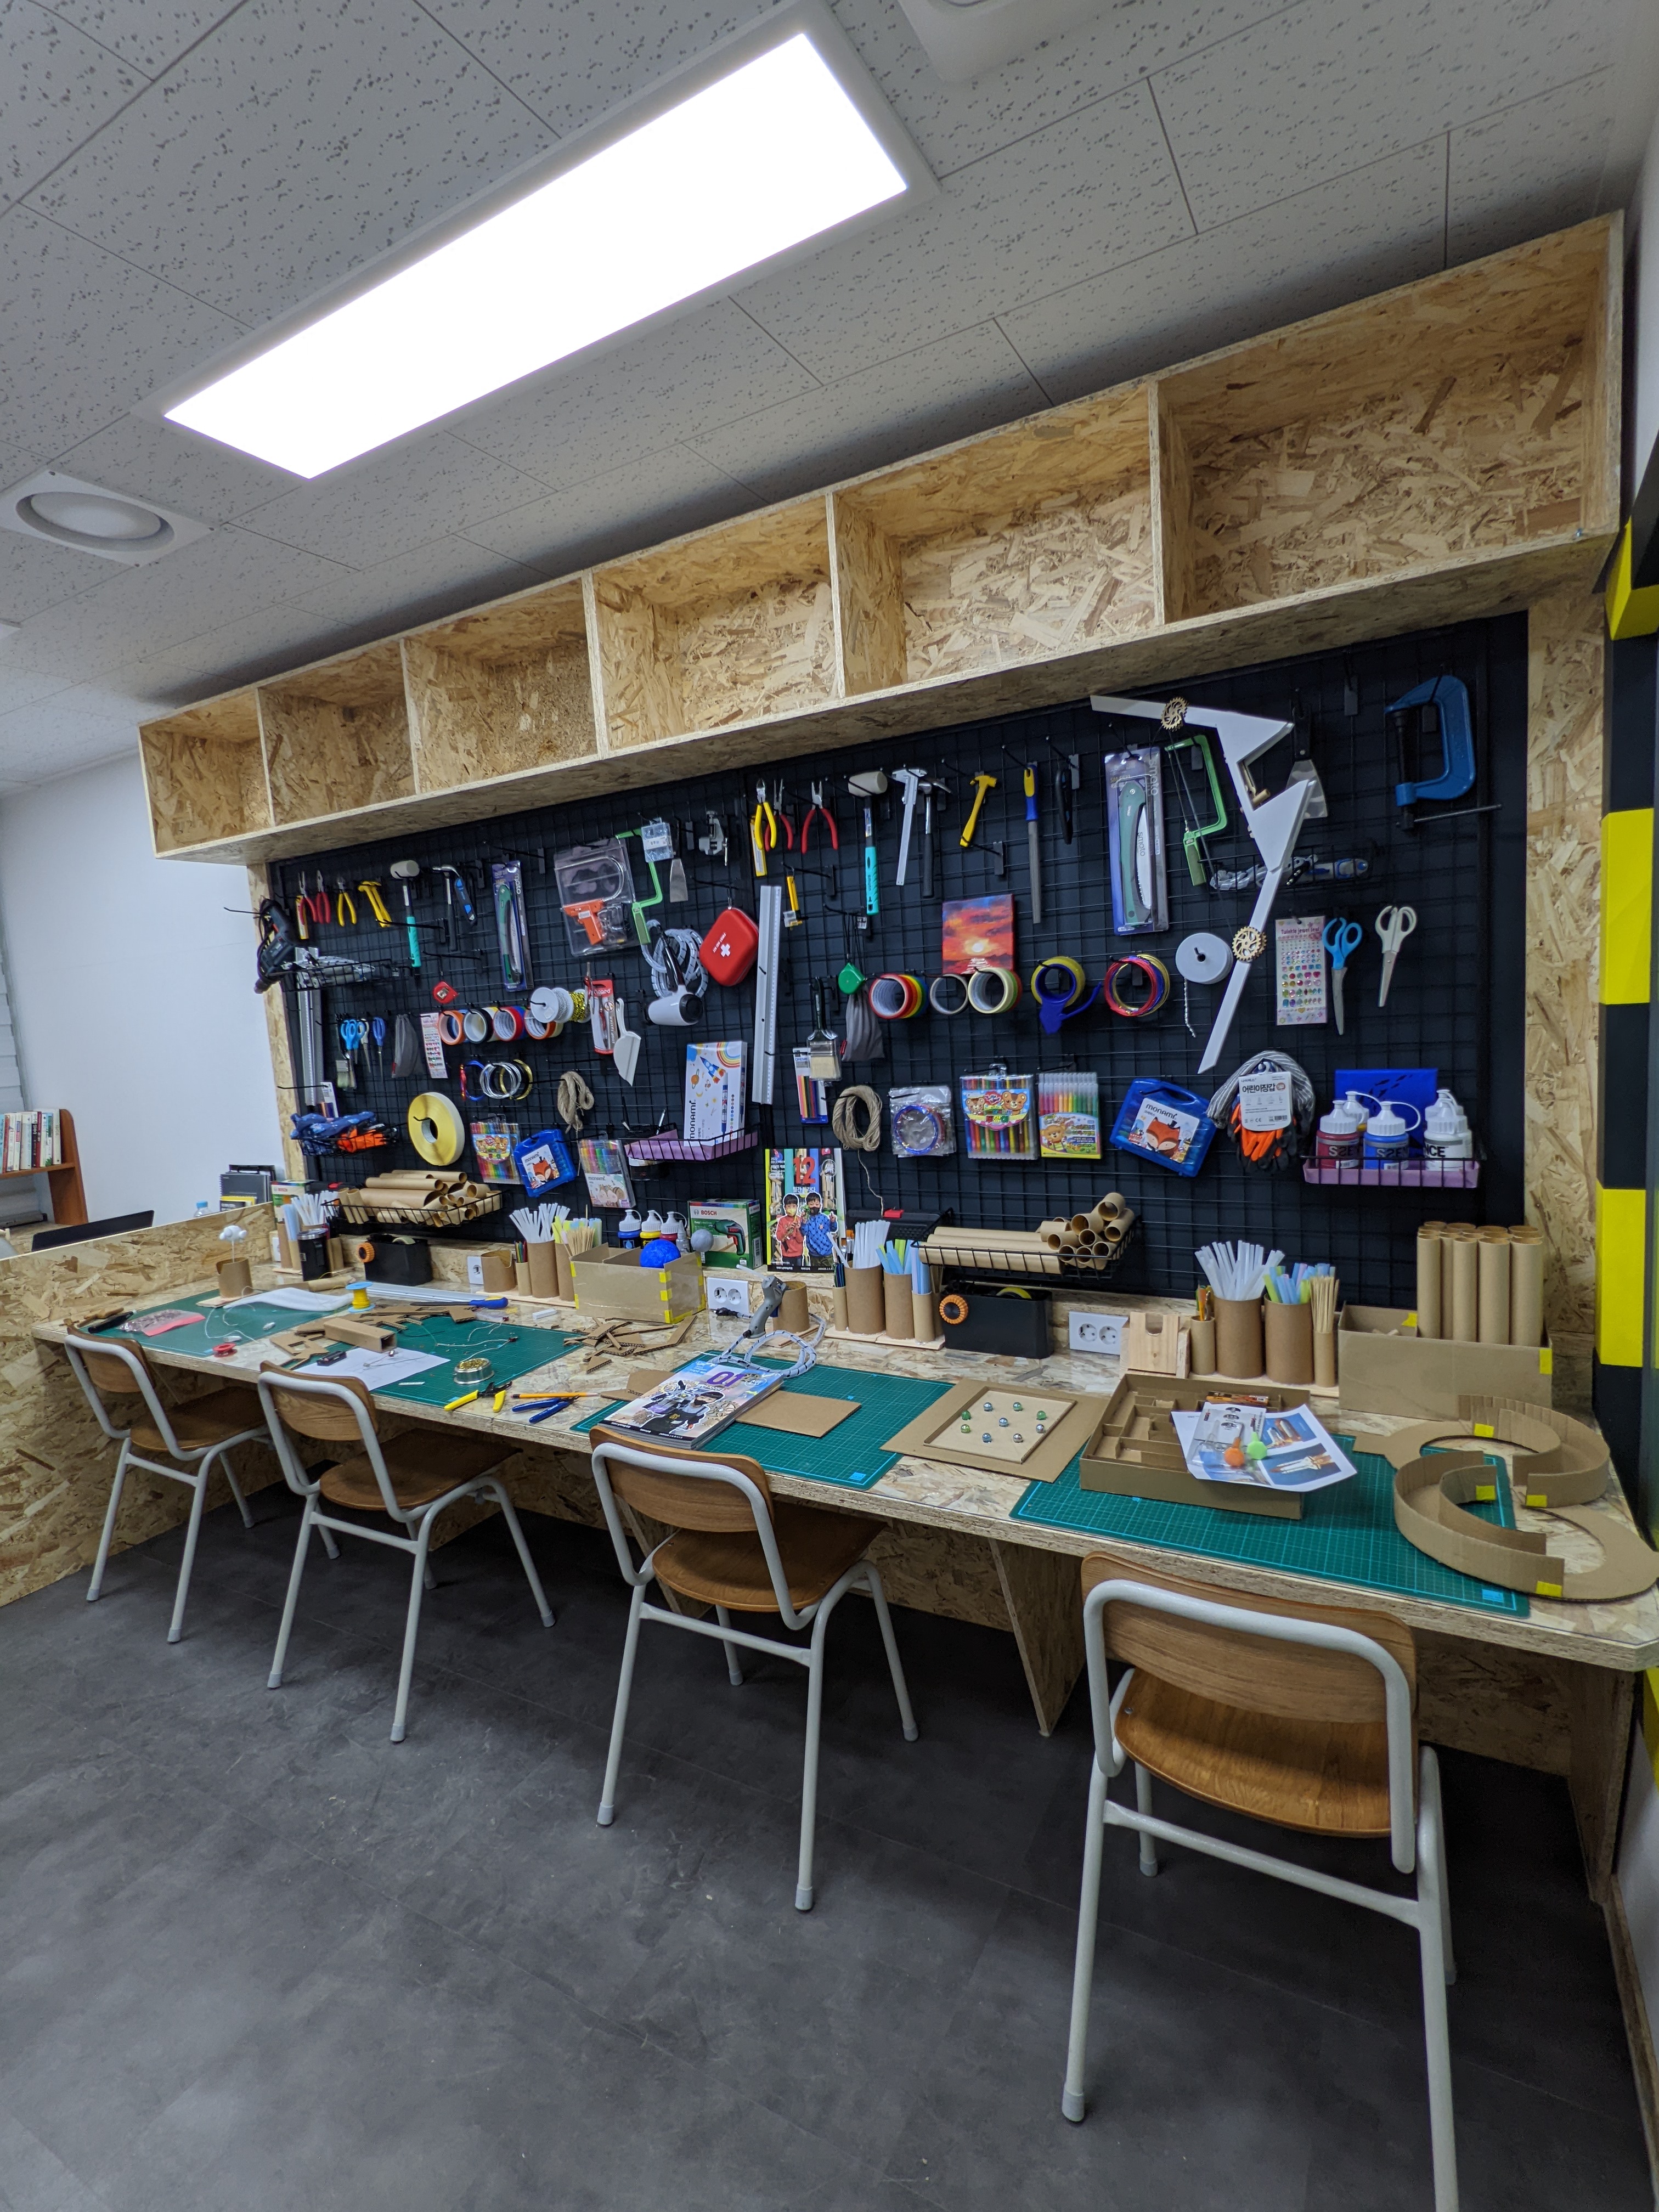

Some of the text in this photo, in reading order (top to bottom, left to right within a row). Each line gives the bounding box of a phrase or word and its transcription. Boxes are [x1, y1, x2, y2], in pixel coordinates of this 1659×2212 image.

[1149, 759, 1159, 796] smato
[1242, 1083, 1276, 1094] 어린이장갑
[1146, 1104, 1178, 1120] monami
[793, 1156, 816, 1184] 12
[707, 1372, 744, 1387] 01
